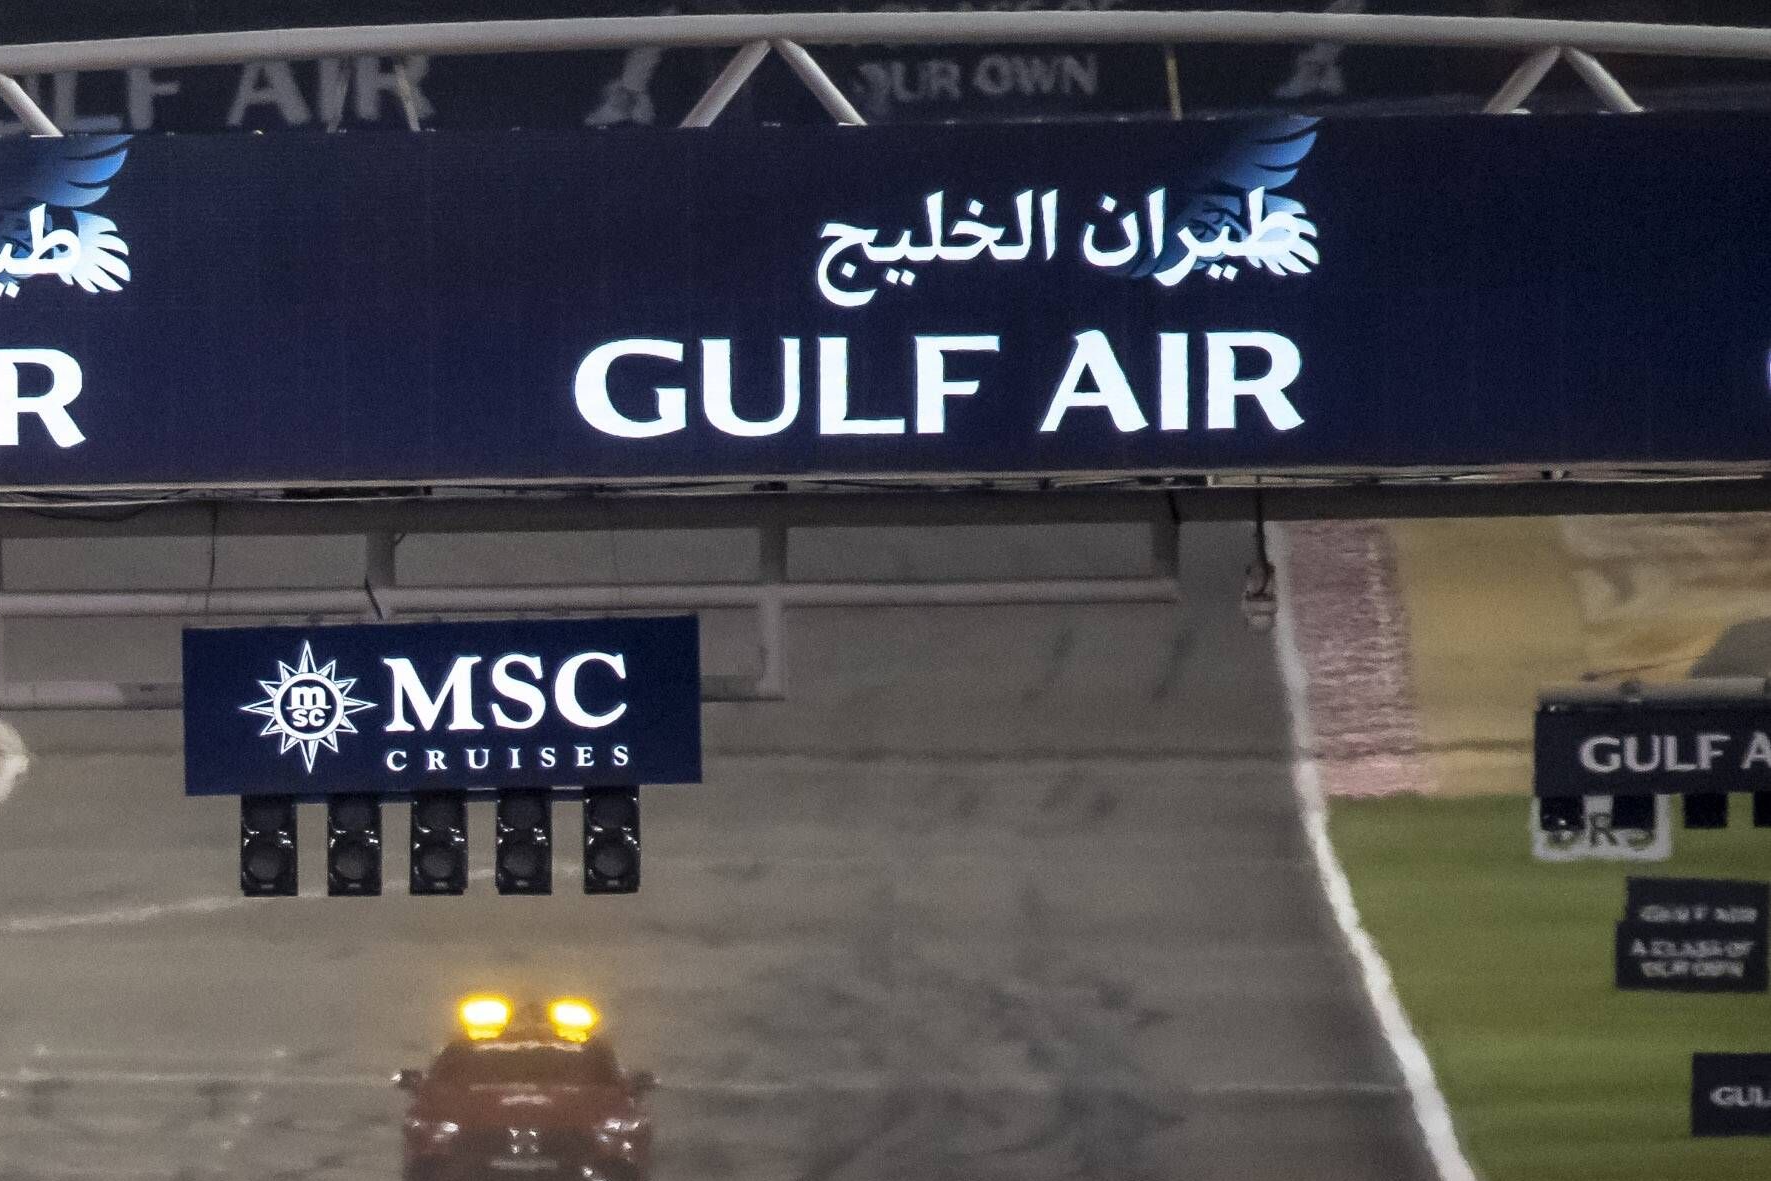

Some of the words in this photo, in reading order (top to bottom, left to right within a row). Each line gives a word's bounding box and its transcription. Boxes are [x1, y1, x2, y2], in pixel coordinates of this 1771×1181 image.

[816, 190, 1058, 307] الخليج
[1083, 186, 1301, 287] طيران
[573, 334, 1000, 439] GULF
[1039, 329, 1305, 433] AIR
[383, 652, 628, 732] MSC
[386, 745, 628, 772] CRUISES
[1580, 733, 1732, 773] GULF
